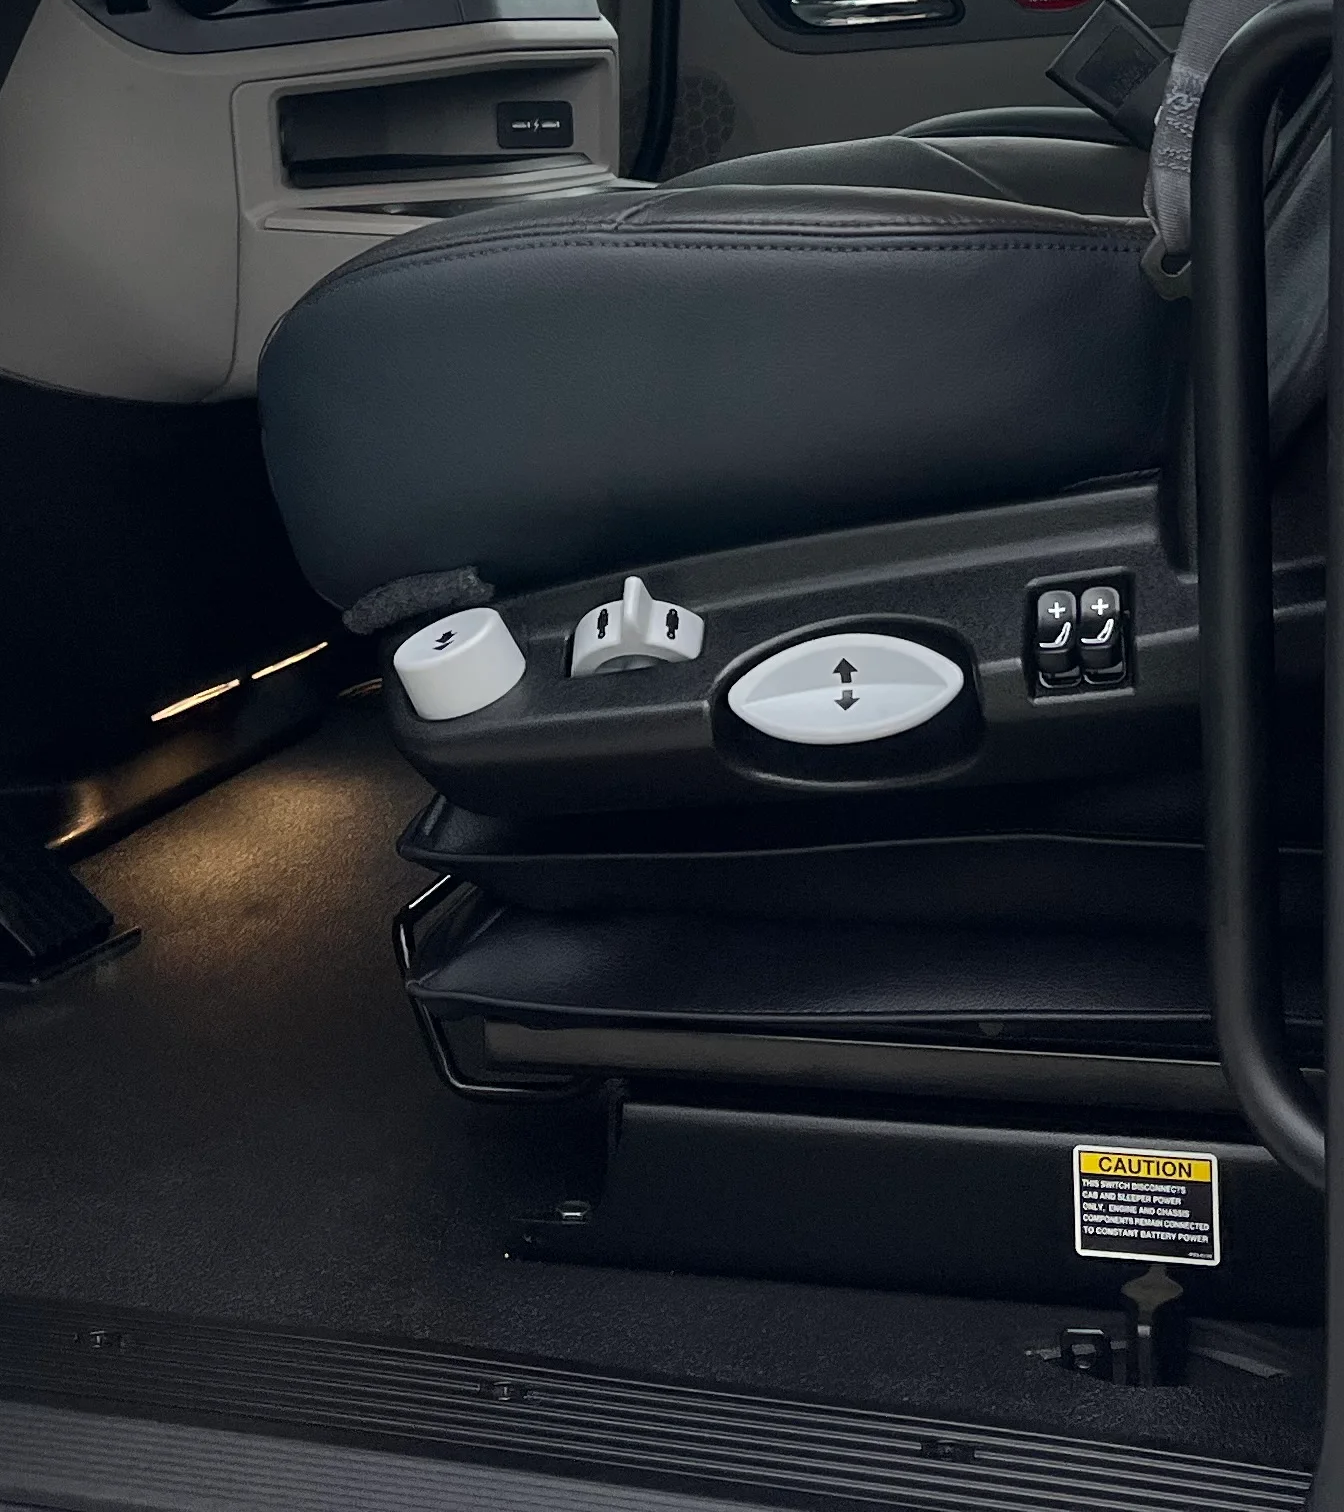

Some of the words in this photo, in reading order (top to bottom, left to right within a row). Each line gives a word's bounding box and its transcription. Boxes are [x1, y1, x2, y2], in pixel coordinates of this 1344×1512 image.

[1098, 1156, 1192, 1178] CAUTION
[1082, 1178, 1100, 1188] THIS
[1100, 1180, 1131, 1190] SWITCH
[1131, 1182, 1187, 1194] DISCONNECTS
[1082, 1190, 1099, 1200] CAB
[1099, 1191, 1116, 1201] AND
[1117, 1193, 1152, 1204] SLEEPER
[1152, 1195, 1182, 1206] POWER
[1108, 1204, 1138, 1215] ENGINE
[1138, 1206, 1156, 1216] AND
[1156, 1208, 1190, 1219] CHASSIS
[1082, 1213, 1134, 1226] COMPONENTS
[1134, 1218, 1163, 1228] REMAIN
[1163, 1220, 1210, 1232] CONNECTED
[1082, 1225, 1095, 1235] TO
[1095, 1226, 1139, 1238] CONSTANT
[1139, 1230, 1177, 1241] BATTERY
[1177, 1233, 1209, 1244] POWER
